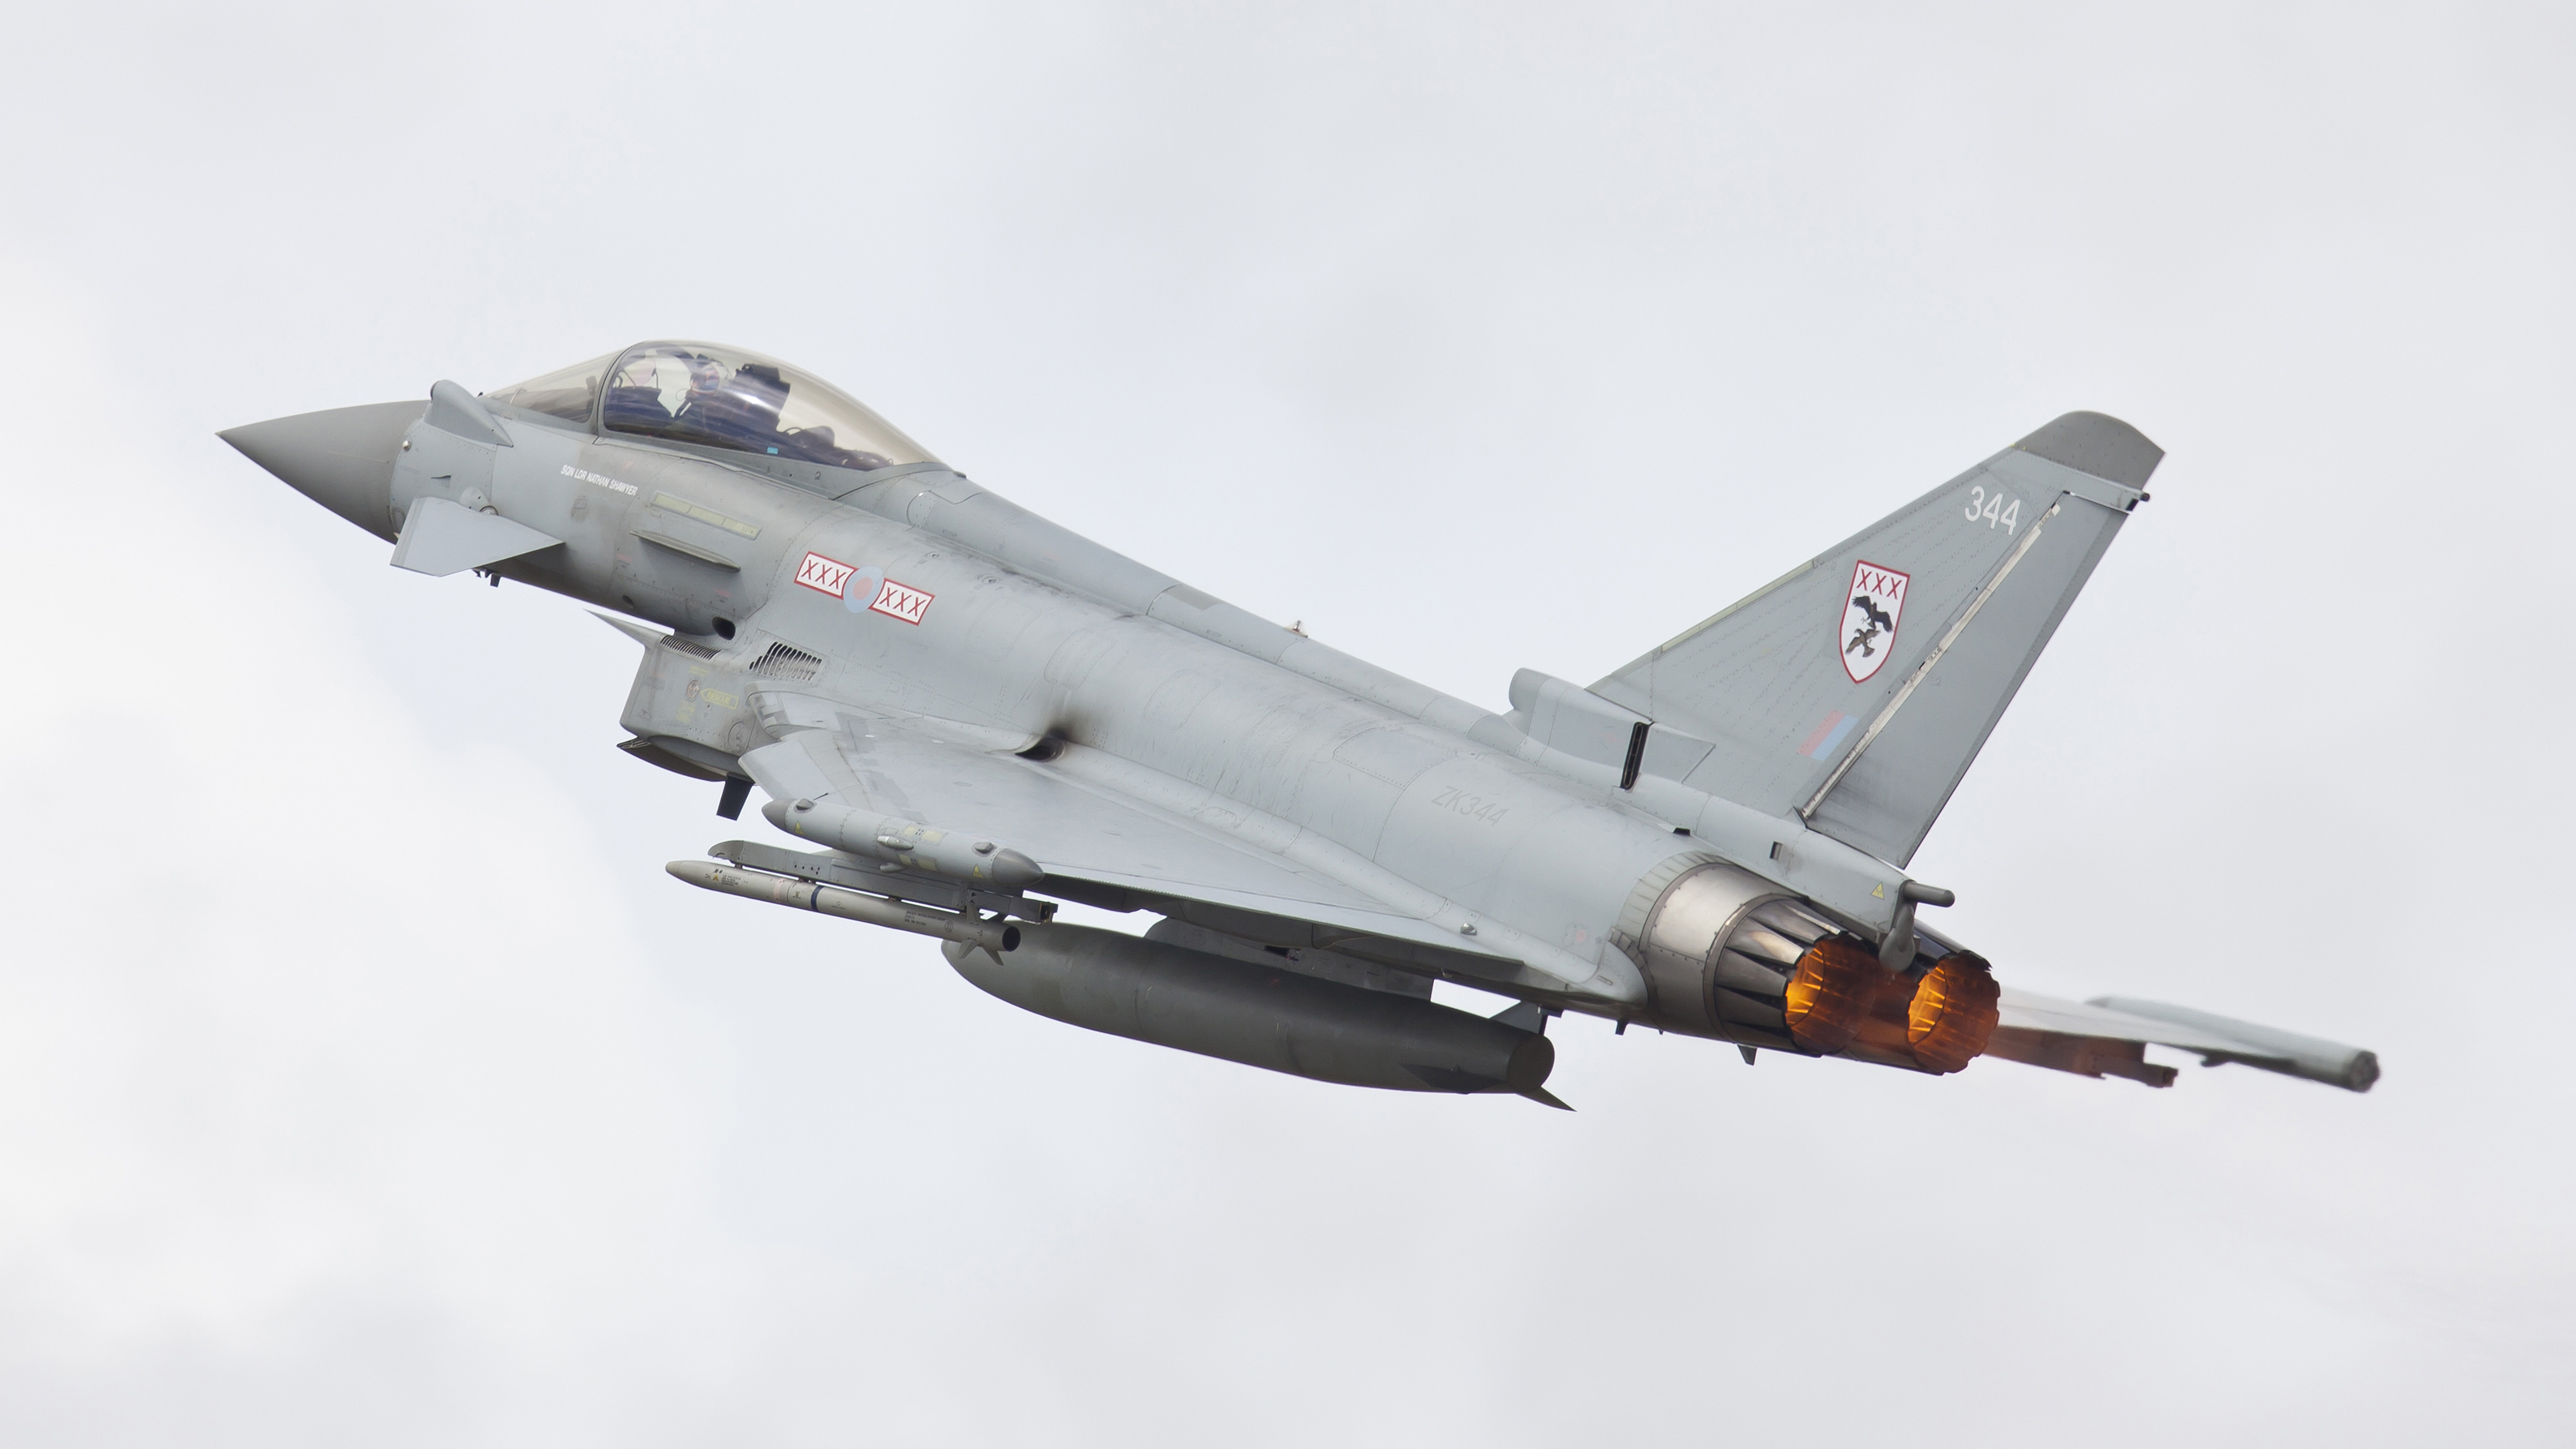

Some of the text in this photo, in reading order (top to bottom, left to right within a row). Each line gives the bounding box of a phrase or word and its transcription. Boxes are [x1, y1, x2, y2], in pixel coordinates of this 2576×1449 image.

[574, 469, 588, 480] LDR
[586, 473, 610, 487] NATHAN
[609, 479, 638, 496] SHAWYER
[1965, 486, 2021, 536] 344
[801, 560, 926, 617] XXX XXX
[1856, 569, 1902, 599] XXX
[1431, 786, 1510, 826] ZK344
